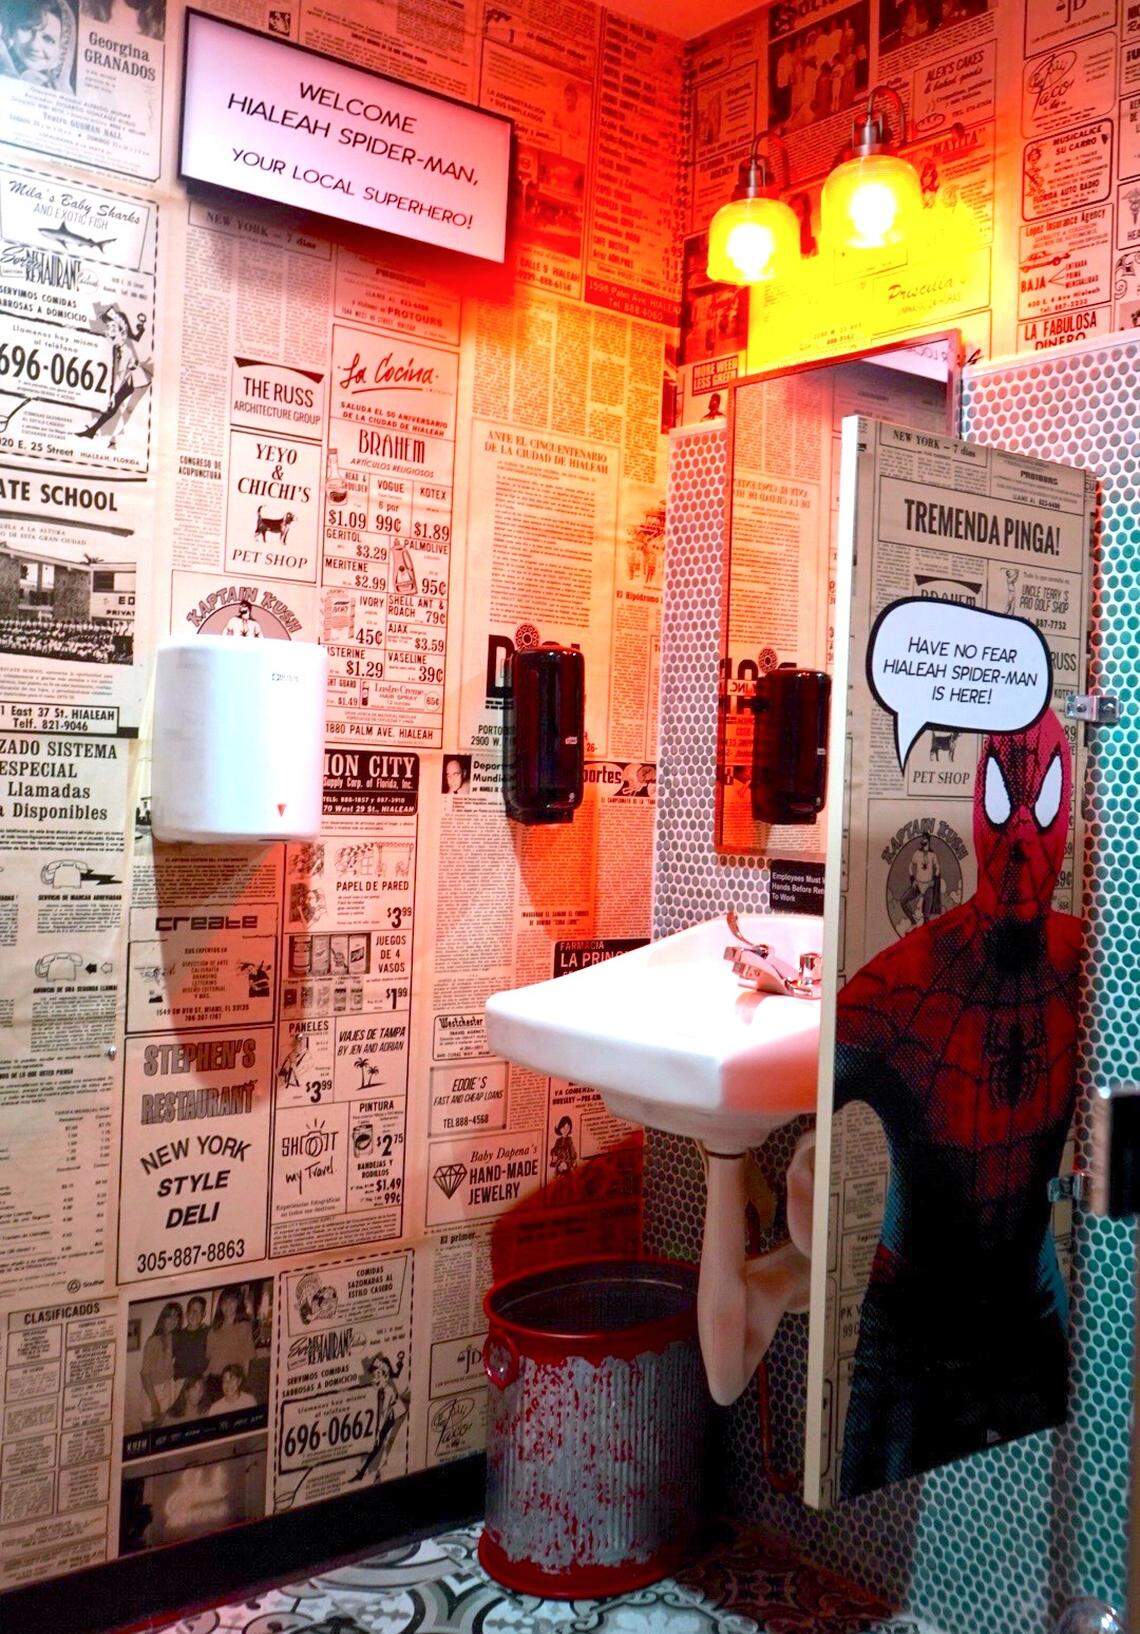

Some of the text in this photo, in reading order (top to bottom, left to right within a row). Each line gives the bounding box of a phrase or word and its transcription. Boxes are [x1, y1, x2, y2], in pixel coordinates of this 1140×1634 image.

[89, 31, 150, 62] Georgina
[84, 48, 156, 82] GRANADOS
[299, 82, 417, 134] WELCOME
[227, 93, 480, 186] HIALEAH SPIDER-MAN,
[1069, 137, 1097, 151] CARRO
[231, 148, 473, 230] YOUR LOCAL SUPERHERO!
[1061, 179, 1099, 196] AUTO RADIO
[33, 203, 108, 230] AND EXOTIC FISH
[61, 193, 140, 225] Baby Sharks
[1081, 209, 1105, 223] Agency
[206, 211, 268, 239] NEW YORK
[1021, 277, 1046, 293] BAJA
[42, 294, 77, 309] COMIDAS
[1024, 311, 1097, 341] LA FABULOSA
[340, 353, 434, 389] La Cocina
[243, 376, 313, 408] THE RUSS
[234, 400, 320, 426] ARCHITECTURE GROUP
[341, 402, 448, 429] SALUDA ANIVERSARIO
[369, 415, 445, 437] CIUDAD HIALEAH
[359, 429, 426, 464] BRAHEM
[893, 430, 940, 450] NEW YORK
[31, 442, 43, 452] 25
[47, 444, 74, 457] Street
[80, 452, 110, 462] HIALEAH
[113, 456, 140, 466] FLORIDA
[256, 443, 298, 465] YEYO
[485, 441, 608, 475] DE LA CIUDAD DE HIALEAH
[530, 437, 607, 463] CINCUENTENARIO
[272, 465, 284, 481] &
[238, 477, 311, 503] CHICHI'S
[378, 480, 405, 493] VOGUE
[420, 487, 447, 500] KOTEX
[41, 483, 118, 512] SCHOOL
[328, 509, 367, 530] $1.09
[376, 514, 401, 533] 99¢
[904, 499, 1060, 557] TREMENDA PINGA!
[326, 528, 361, 542] GERITOL
[414, 521, 450, 542] $1.89
[356, 545, 387, 561] $3.29
[404, 539, 449, 555] PALMOLIVE
[232, 549, 308, 569] PET SHOP
[325, 558, 369, 573] MERITENE
[355, 575, 386, 591] $2.99
[422, 578, 447, 596] 95¢
[1022, 585, 1041, 598] UNCLE
[186, 586, 302, 633] KAPTAIN KUSH
[360, 595, 384, 608] IVORY
[389, 595, 433, 608] SHELL ANT
[1020, 596, 1069, 614] PRO GOLF SHOP
[388, 606, 416, 618] ROACH
[426, 611, 446, 625] 79¢
[356, 627, 383, 646] 45¢
[388, 623, 408, 634] AJAX
[415, 638, 445, 653] $3.59
[908, 637, 1017, 663] HAVE NO FEAR
[388, 652, 427, 665] VASELINE
[346, 660, 383, 679] $1.29
[419, 666, 444, 683] 39¢
[883, 659, 1037, 687] HIALEAH SPIDER-MAN
[932, 686, 993, 704] IS HERE!
[11, 706, 115, 721] East 37 St. HIALEAH
[13, 718, 88, 732] Telf. 821-9046
[350, 725, 434, 740] PALM AVE. HIALEAH
[47, 741, 118, 759] SISTEMA
[0, 760, 78, 778] ESPECIAL
[369, 755, 415, 778] CITY
[347, 778, 363, 789] Corp.
[913, 771, 970, 785] PET SHOP
[7, 781, 91, 799] Llamadas
[13, 803, 108, 821] Disponibles
[336, 881, 409, 891] PAPEL DE PARED
[772, 872, 821, 884] Employees Must
[772, 882, 791, 891] Hands
[792, 884, 812, 893] Before
[780, 893, 796, 902] Work
[155, 916, 258, 931] create
[376, 935, 407, 946] JUEGOS
[380, 950, 391, 960] DE
[560, 954, 577, 968] LA
[378, 963, 405, 973] VASOS
[289, 1021, 329, 1033] PANELES
[339, 1026, 407, 1042] VIAJES DE TAMPA
[349, 1041, 405, 1055] JEN ADRIAN
[143, 1038, 257, 1077] STEPHEN'S
[452, 1076, 488, 1093] EDDIE'S
[141, 1079, 258, 1125] RESTAURANT
[360, 1100, 394, 1113] PINTURA
[434, 1090, 503, 1106] FAST LOANS
[140, 1137, 190, 1176] NEW
[197, 1135, 251, 1162] YORK
[471, 1146, 538, 1163] Baby Dapena's
[469, 1159, 538, 1185] HAND-MADE
[157, 1169, 231, 1198] STYLE
[376, 1178, 402, 1193] $1.49
[468, 1181, 521, 1206] JEWELRY
[165, 1201, 220, 1230] DELI
[138, 1239, 245, 1274] 305-887-8863
[357, 1266, 384, 1277] COMIDAS
[24, 1302, 100, 1325] CLASIFICADOS
[321, 1365, 349, 1378] COMIDAS
[284, 1409, 374, 1457] 696-0662
